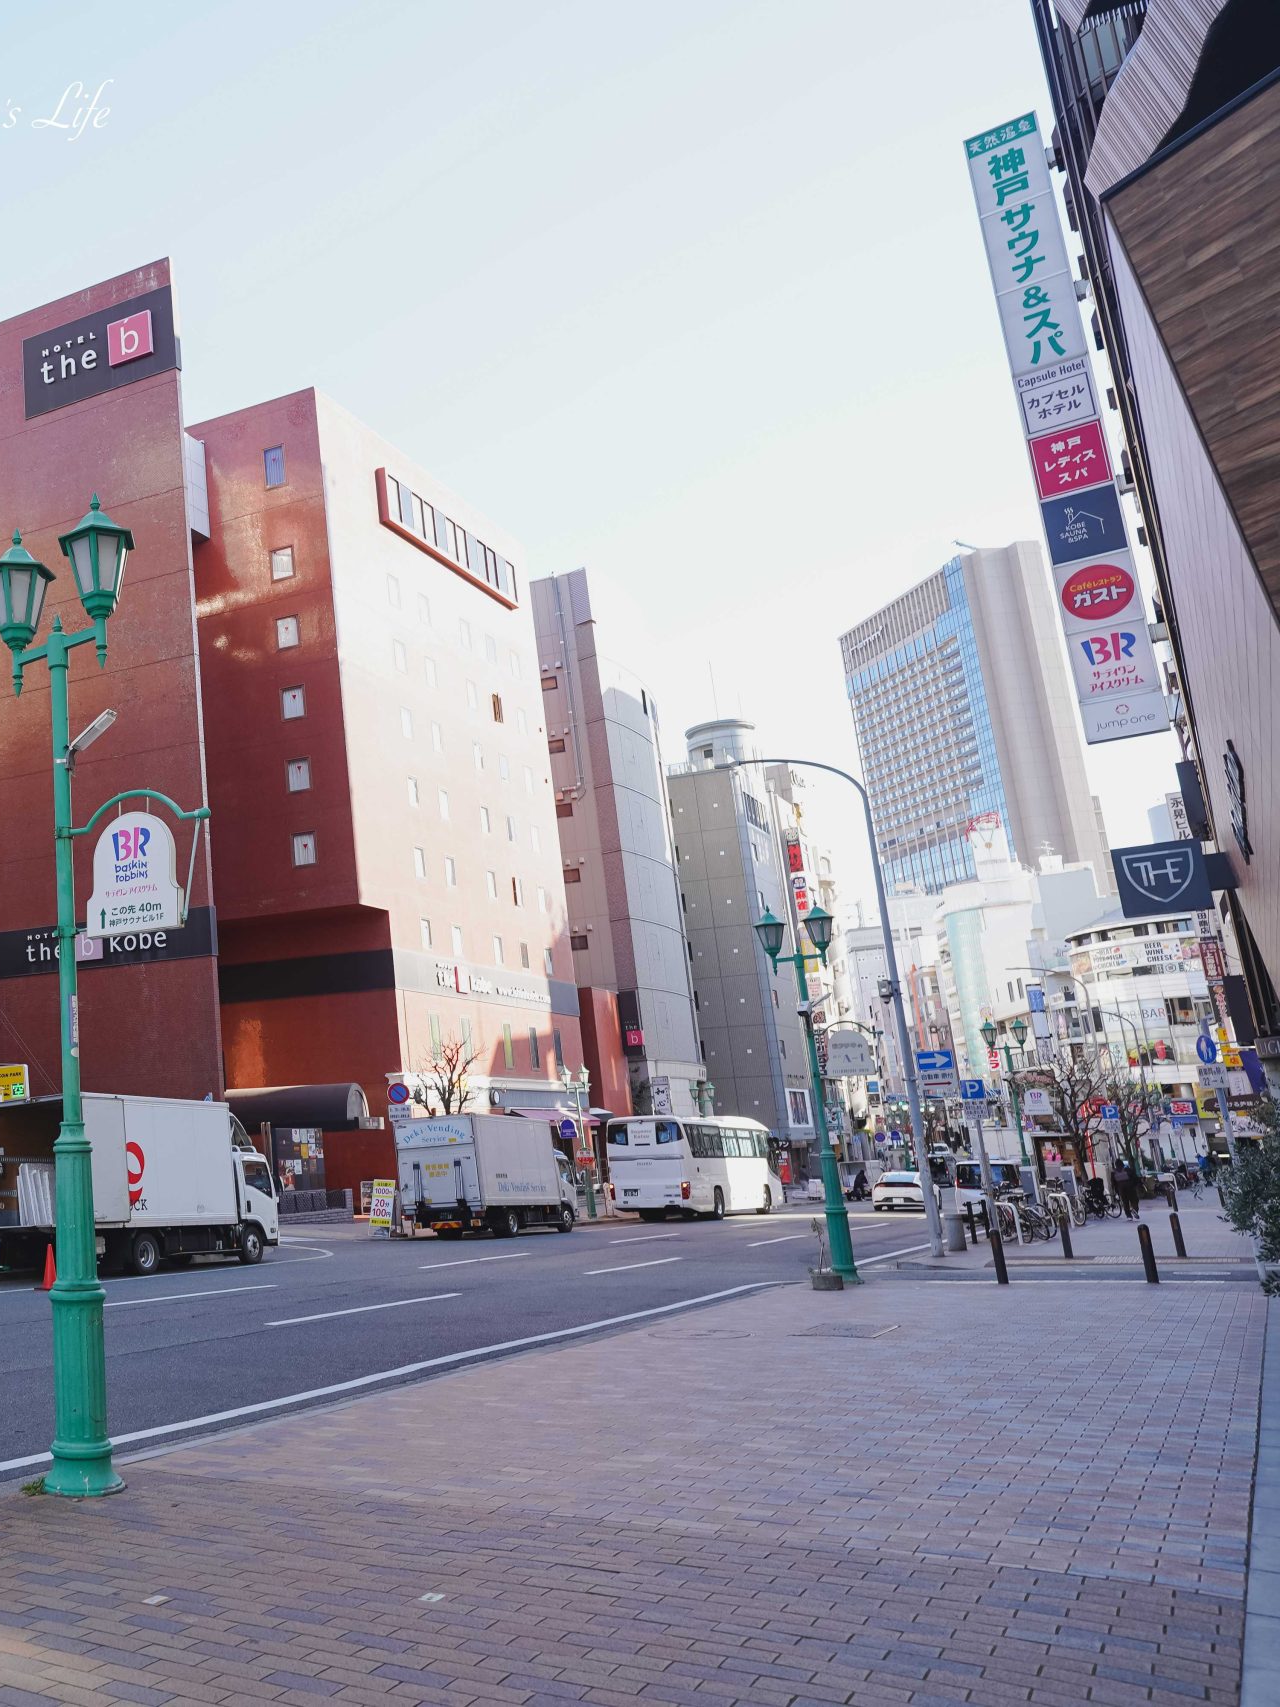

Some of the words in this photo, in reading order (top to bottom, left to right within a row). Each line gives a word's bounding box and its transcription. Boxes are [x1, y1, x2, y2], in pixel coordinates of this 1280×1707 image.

[41, 332, 97, 358] HOTEL
[40, 349, 98, 384] the
[1017, 369, 1057, 389] Capsule
[1059, 359, 1086, 376] Hotel
[1027, 384, 1085, 410] カプセル
[1037, 399, 1082, 420] ホテル
[1050, 435, 1082, 454] 神戸
[1044, 448, 1097, 472] レディス
[1059, 528, 1088, 540] SAUNA
[1065, 521, 1086, 532] KOBE
[1073, 585, 1127, 608] ガスト
[1080, 632, 1136, 666] BR
[1130, 712, 1156, 725] one
[111, 826, 151, 861] BR
[114, 860, 148, 873] baskin
[115, 869, 148, 883] robbins
[1132, 857, 1183, 887] THE
[111, 904, 137, 916] この先
[138, 902, 162, 912] 40m
[1145, 948, 1164, 956] WINE
[1146, 954, 1173, 963] CHEESE
[965, 1081, 979, 1098] P
[1105, 1108, 1115, 1117] P
